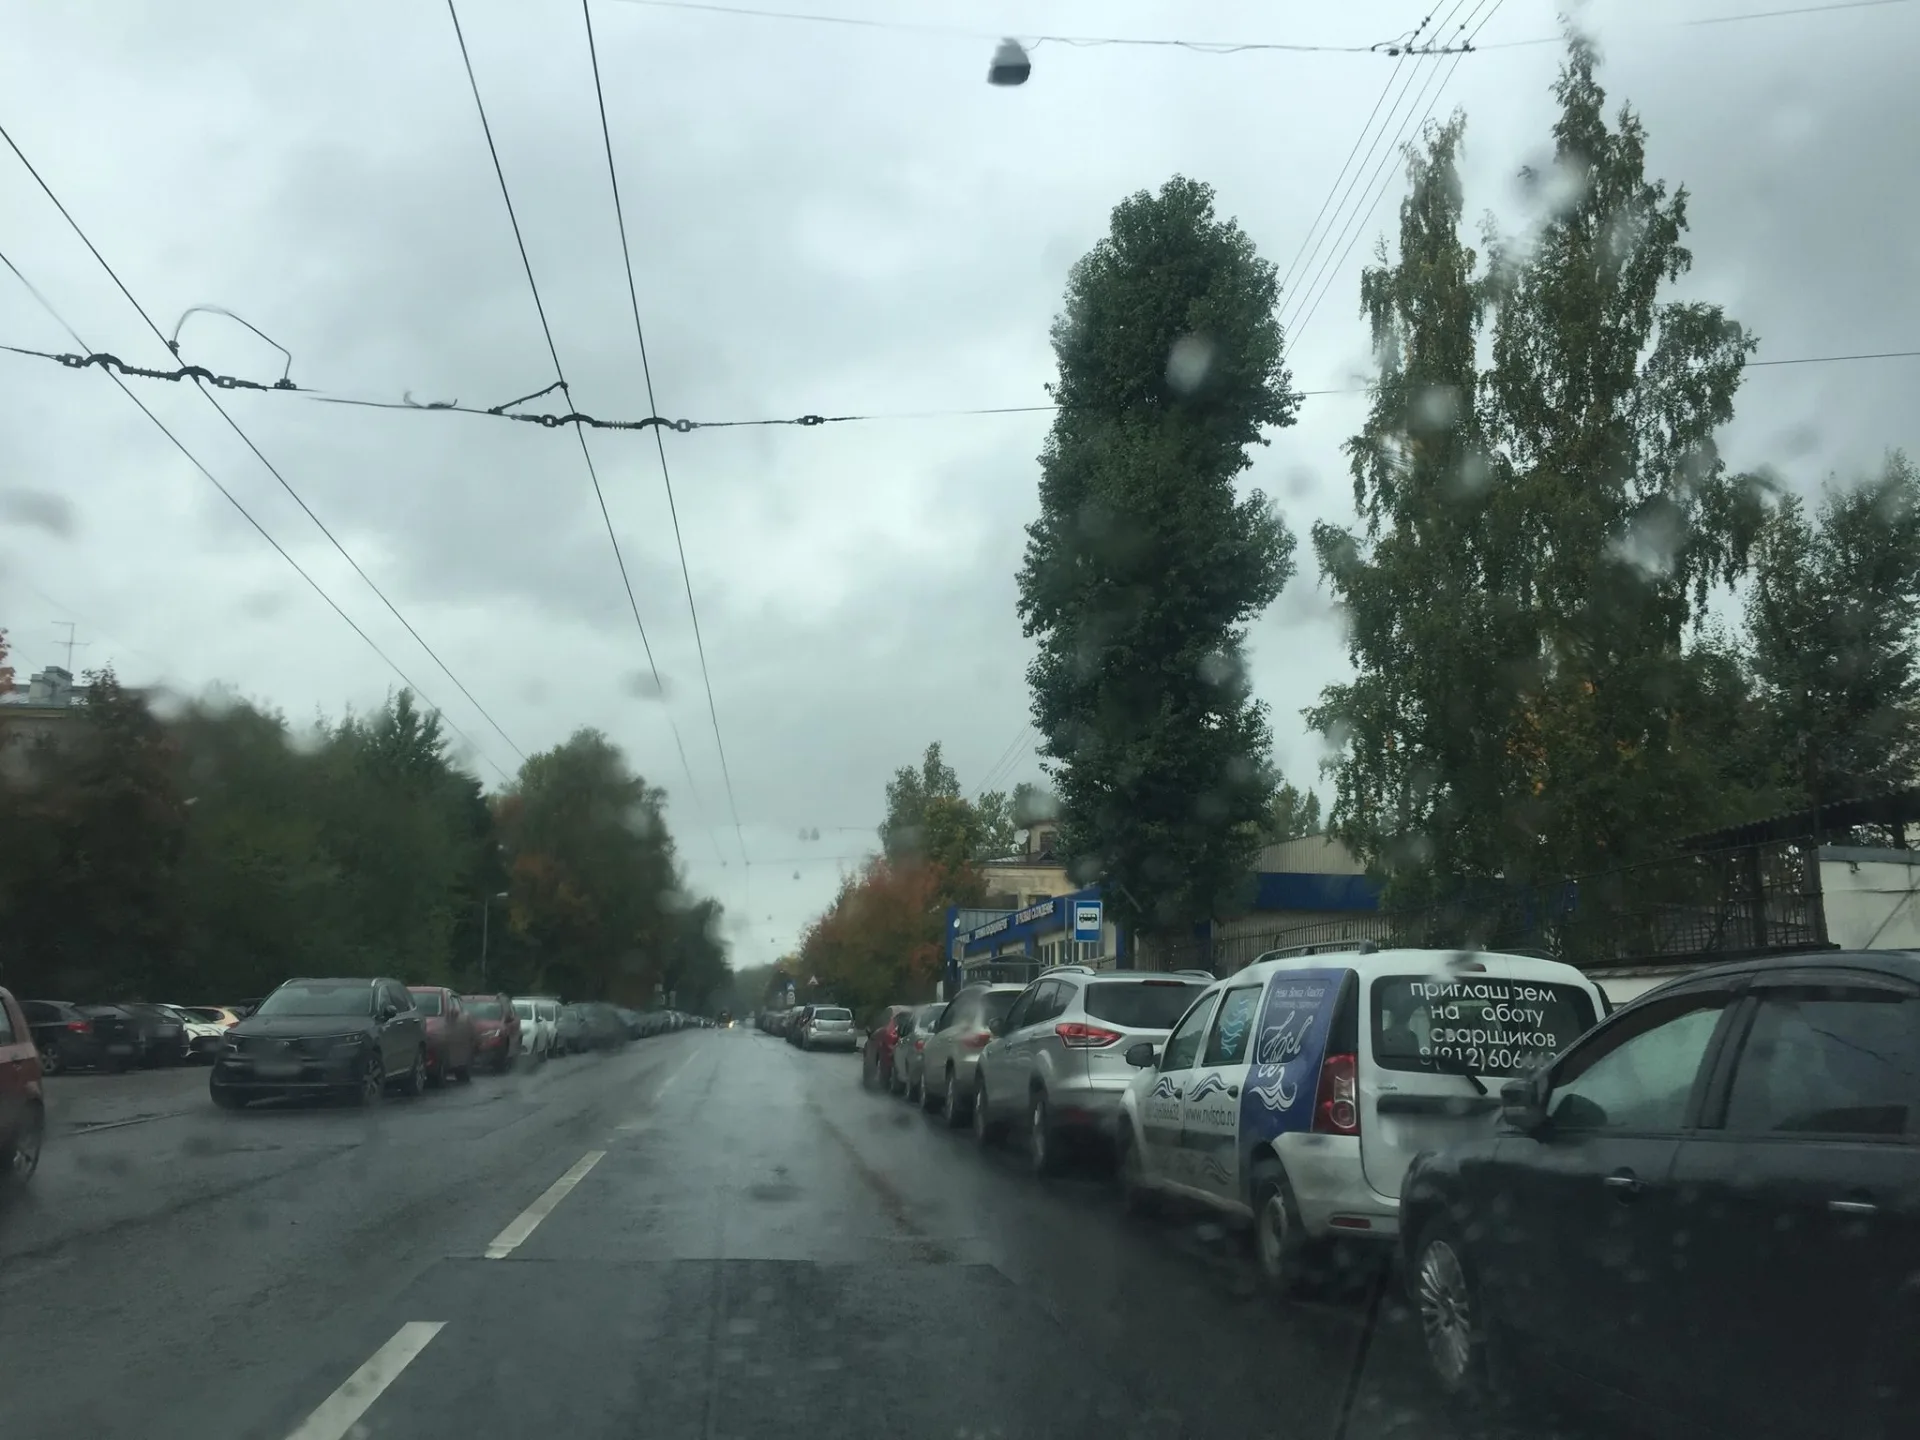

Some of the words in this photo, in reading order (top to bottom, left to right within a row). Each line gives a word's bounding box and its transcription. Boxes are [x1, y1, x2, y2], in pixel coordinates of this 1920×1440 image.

[1410, 983, 1557, 1002] приглашаем
[1431, 1005, 1460, 1020] на
[1430, 1028, 1557, 1047] сварщиков
